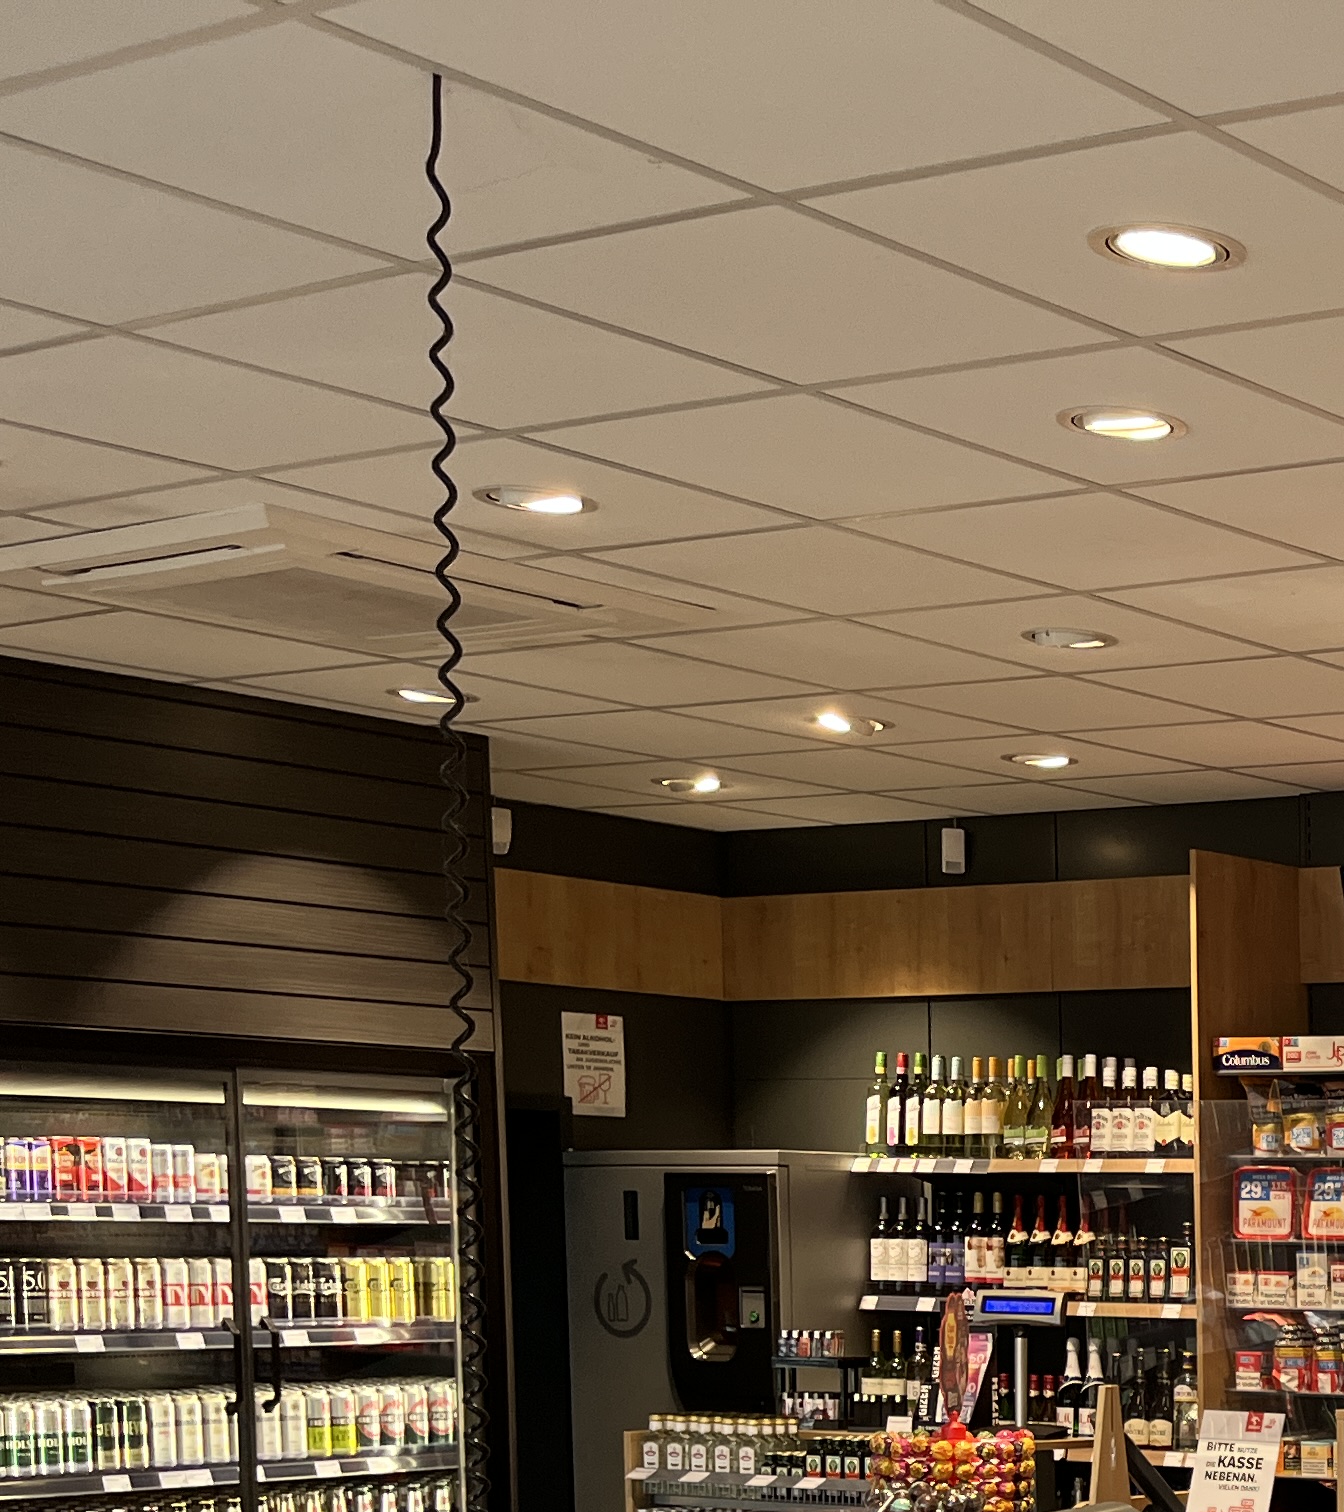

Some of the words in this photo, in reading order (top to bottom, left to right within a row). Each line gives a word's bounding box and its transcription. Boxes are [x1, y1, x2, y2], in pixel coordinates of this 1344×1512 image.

[1222, 1053, 1270, 1067] Columbus
[1242, 1217, 1287, 1229] PARAMOUNT
[1206, 1441, 1236, 1453] BITTE
[1217, 1455, 1265, 1470] KASSE
[1204, 1470, 1258, 1483] NEBENAN.
